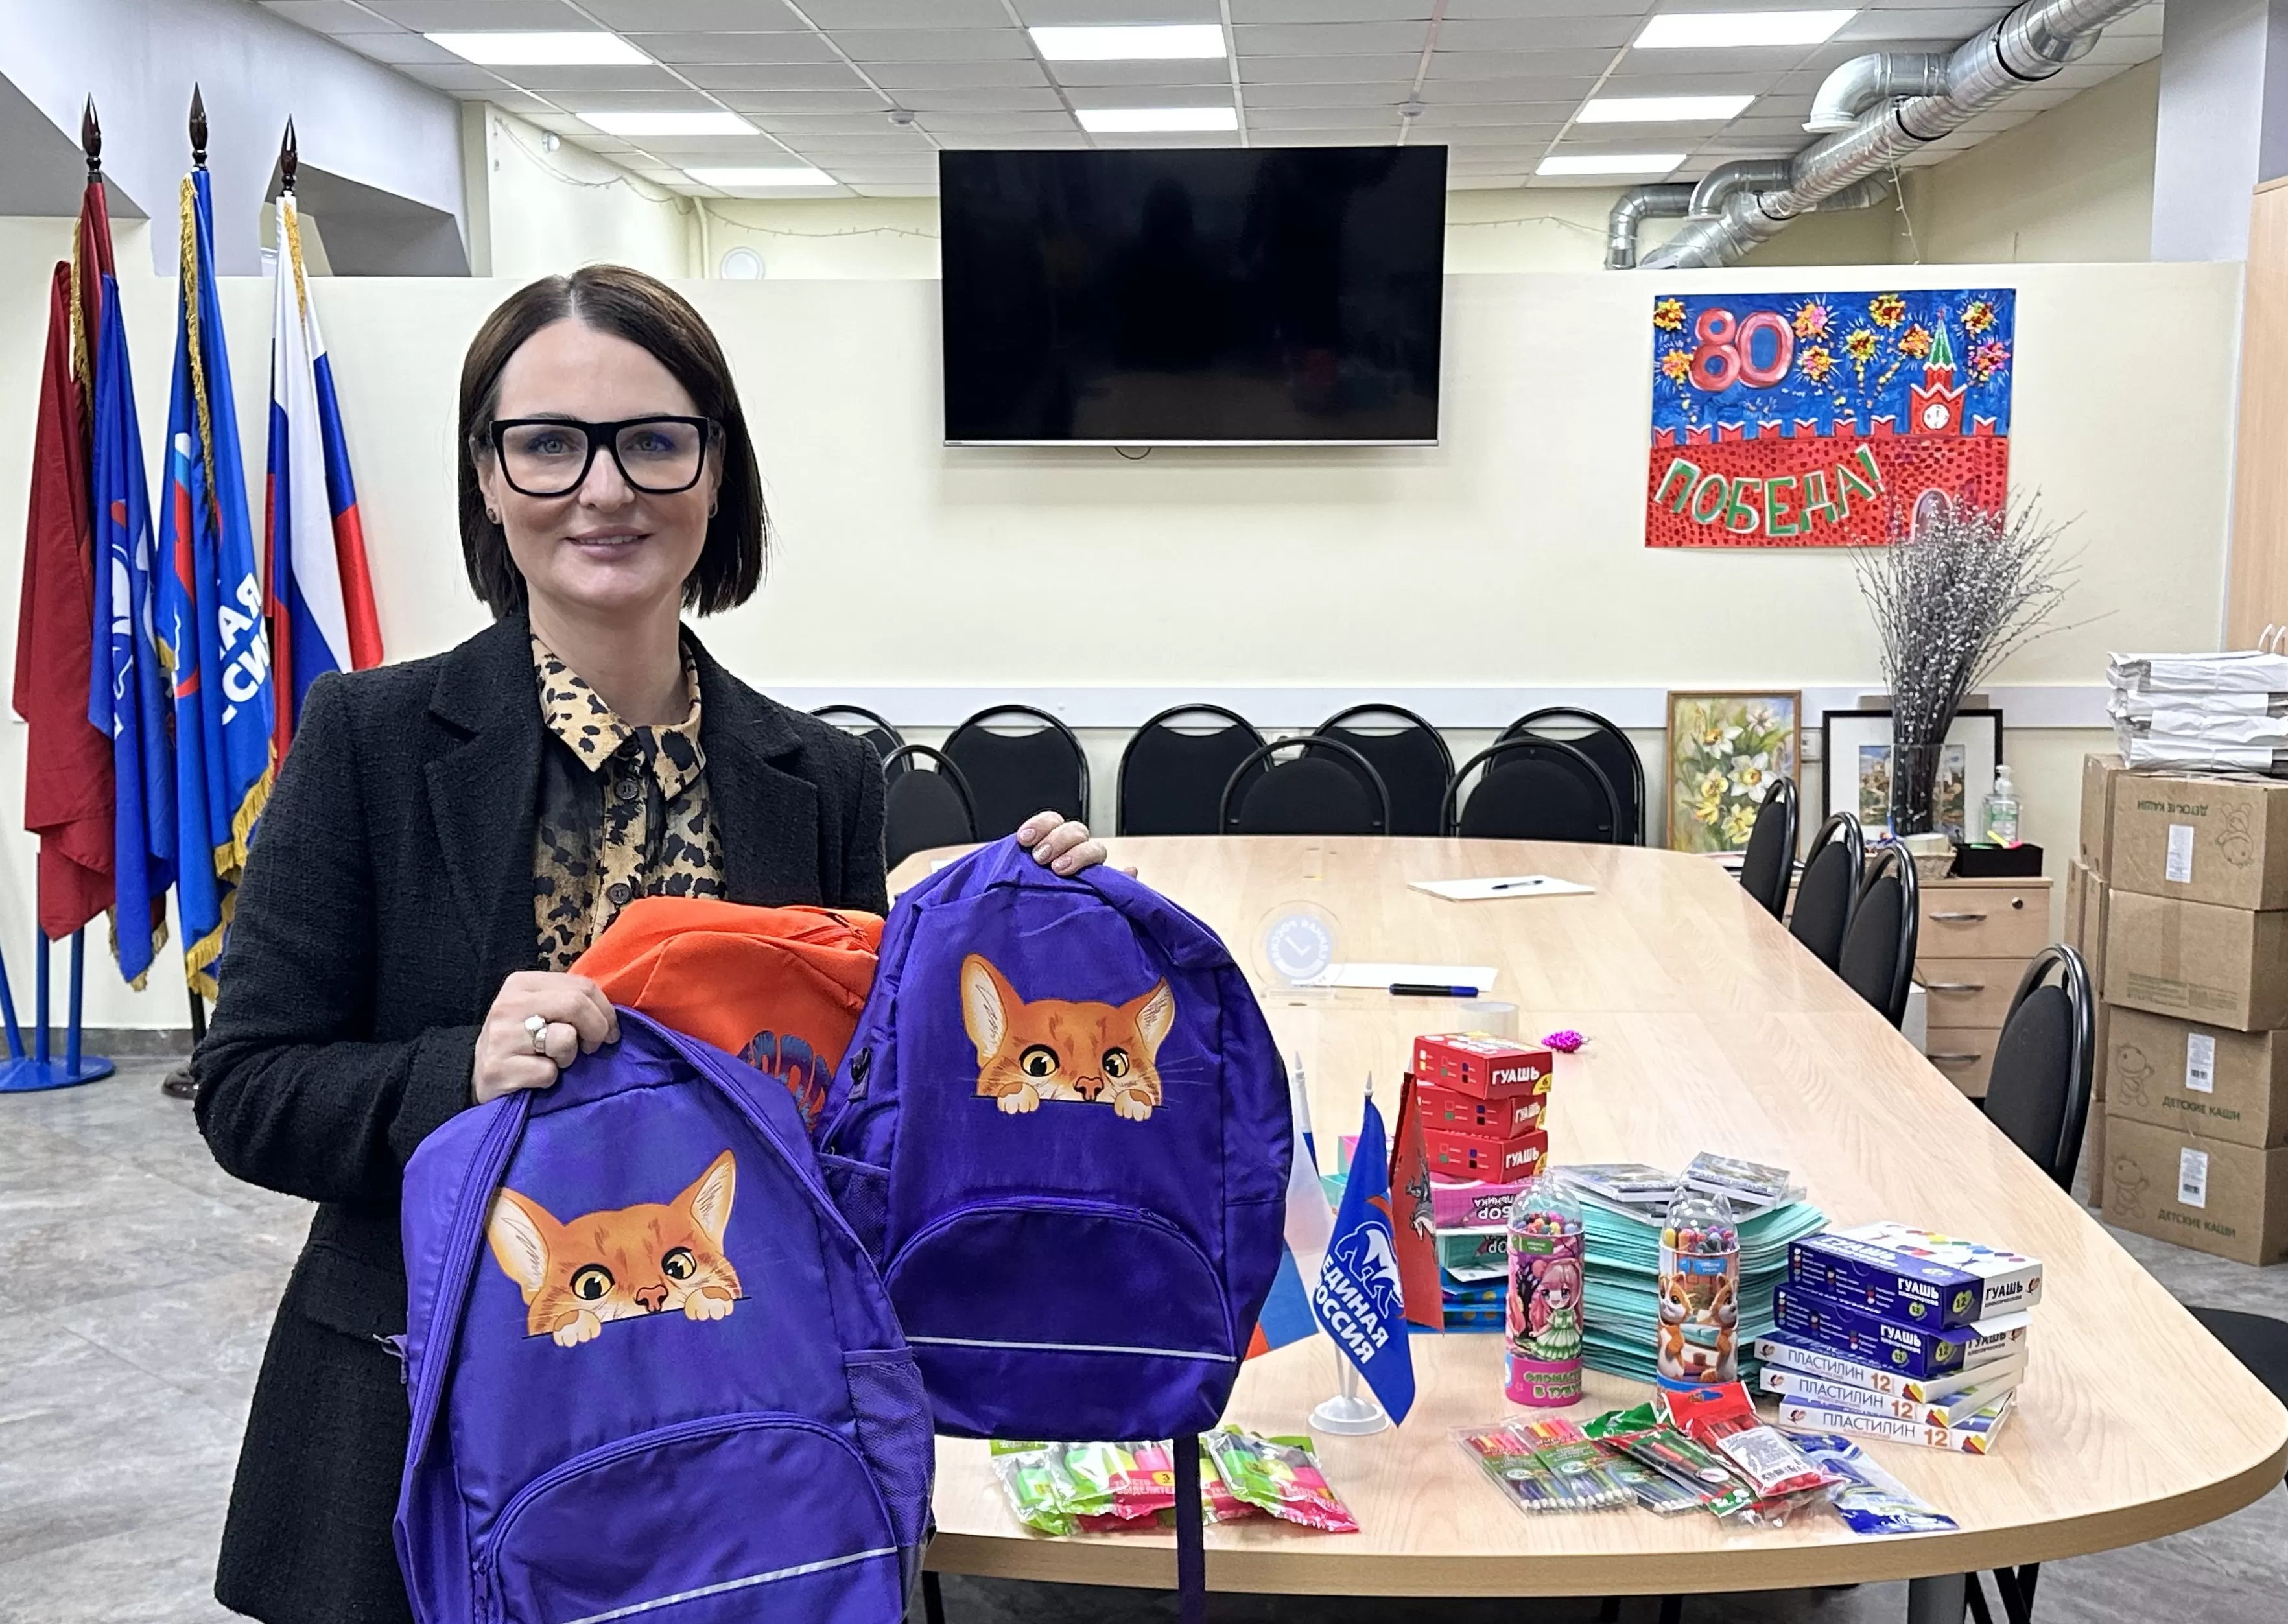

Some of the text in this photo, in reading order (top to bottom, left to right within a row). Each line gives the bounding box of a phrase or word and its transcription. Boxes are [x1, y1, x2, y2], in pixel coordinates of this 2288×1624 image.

[1687, 308, 1795, 392] 80
[1653, 443, 1885, 537] ПОБЕДА!
[1492, 1066, 1540, 1085] ГУАШЬ
[1515, 1102, 1540, 1124] ГУАШЬ
[2162, 1096, 2241, 1122] ДЕТСКИЕ КАШИ
[1505, 1146, 1540, 1169] ГУАШЬ
[2157, 1208, 2237, 1239] ДЕТСКИЕ КАШИ
[1323, 1254, 1389, 1349] ЕДИНАЯ
[1898, 1277, 1940, 1299] ГУАШЬ
[1956, 1296, 1967, 1308] 12
[1985, 1280, 2023, 1300] ГУАШЬ
[1315, 1284, 1375, 1365] ОССИЯ
[1880, 1324, 1922, 1348] ГУАШЬ
[1788, 1349, 1864, 1382] ПЛАСТИЛИН
[1870, 1372, 1892, 1393] 12
[1799, 1379, 1883, 1409] ПЛАСТИЛИН
[1891, 1400, 1913, 1419] 12
[1822, 1413, 1916, 1438] ПЛАСТИЛИН
[1924, 1428, 1949, 1447] 12
